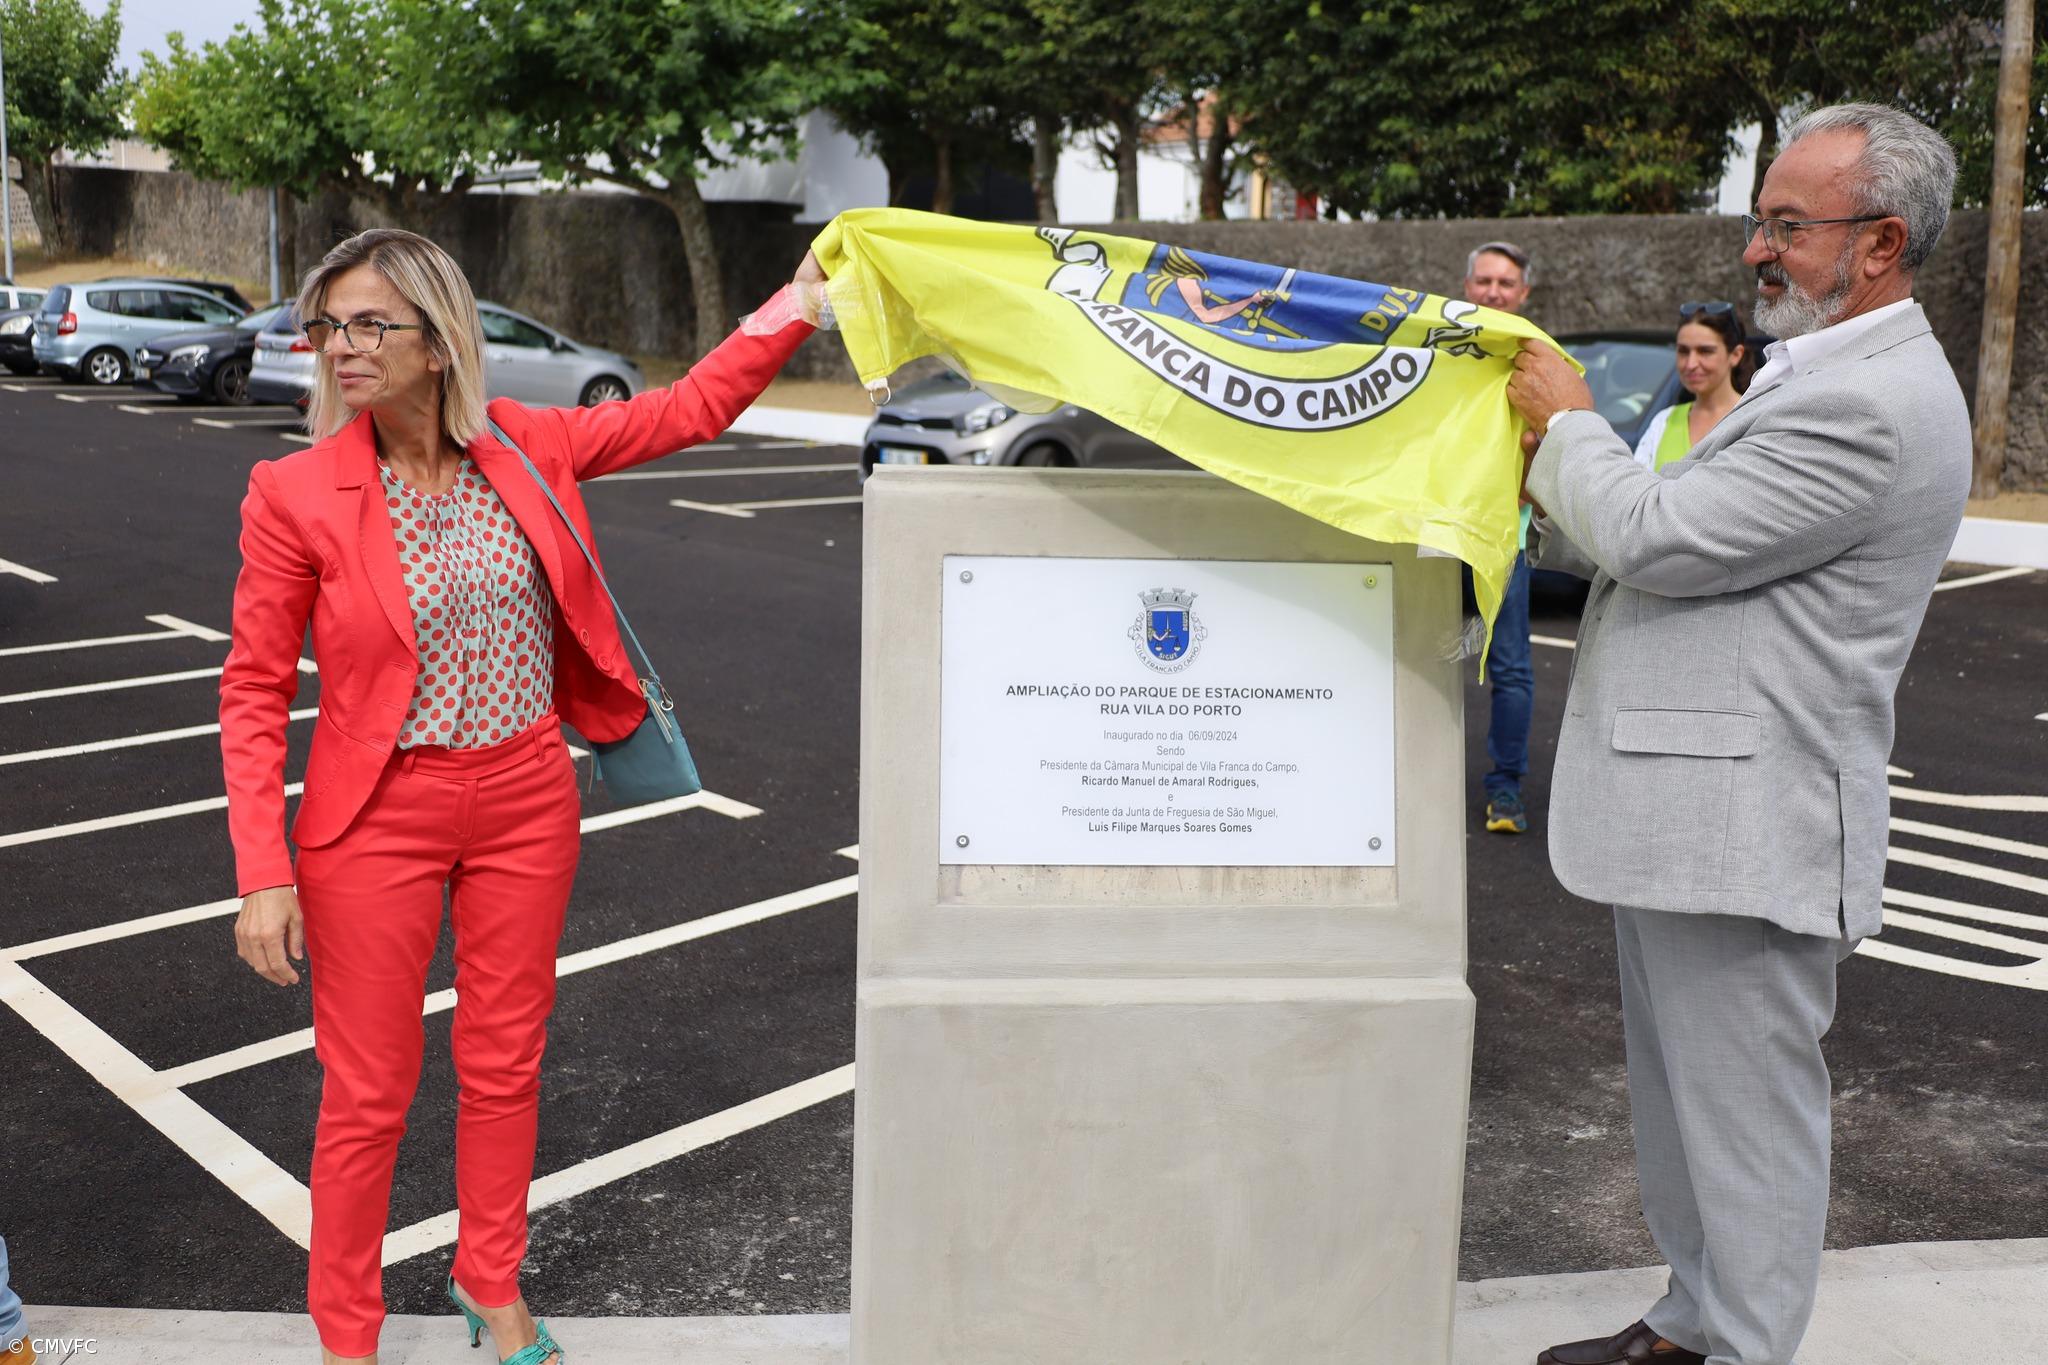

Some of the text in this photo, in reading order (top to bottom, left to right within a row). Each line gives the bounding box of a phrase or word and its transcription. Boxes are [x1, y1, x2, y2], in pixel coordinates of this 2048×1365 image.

[1090, 303, 1418, 422] RANCA DO CAMPO
[1136, 643, 1148, 662] VILA
[1172, 663, 1184, 673] DO
[1183, 645, 1200, 668] CAMPO
[1006, 682, 1333, 700] AMPLIAÇÃO DO PARQUE DE ESTACIONAMENTO
[1101, 703, 1241, 716] RUA VILA DO PORTO
[1104, 730, 1237, 743] Inaugurado no dia 06/09/2024
[1157, 746, 1185, 756] Sendo
[1040, 759, 1299, 774] Presidente da Câmara Municipal de Vila Franca do Campo,
[1082, 775, 1259, 790] Ricardo Manuel de Amaral Rodrigues,
[1167, 793, 1174, 802] e
[1062, 806, 1278, 821] Presidente da Junta de Freguesia de São Miguel,
[1089, 821, 1252, 835] Luis Filipe Marques Soares Gomes
